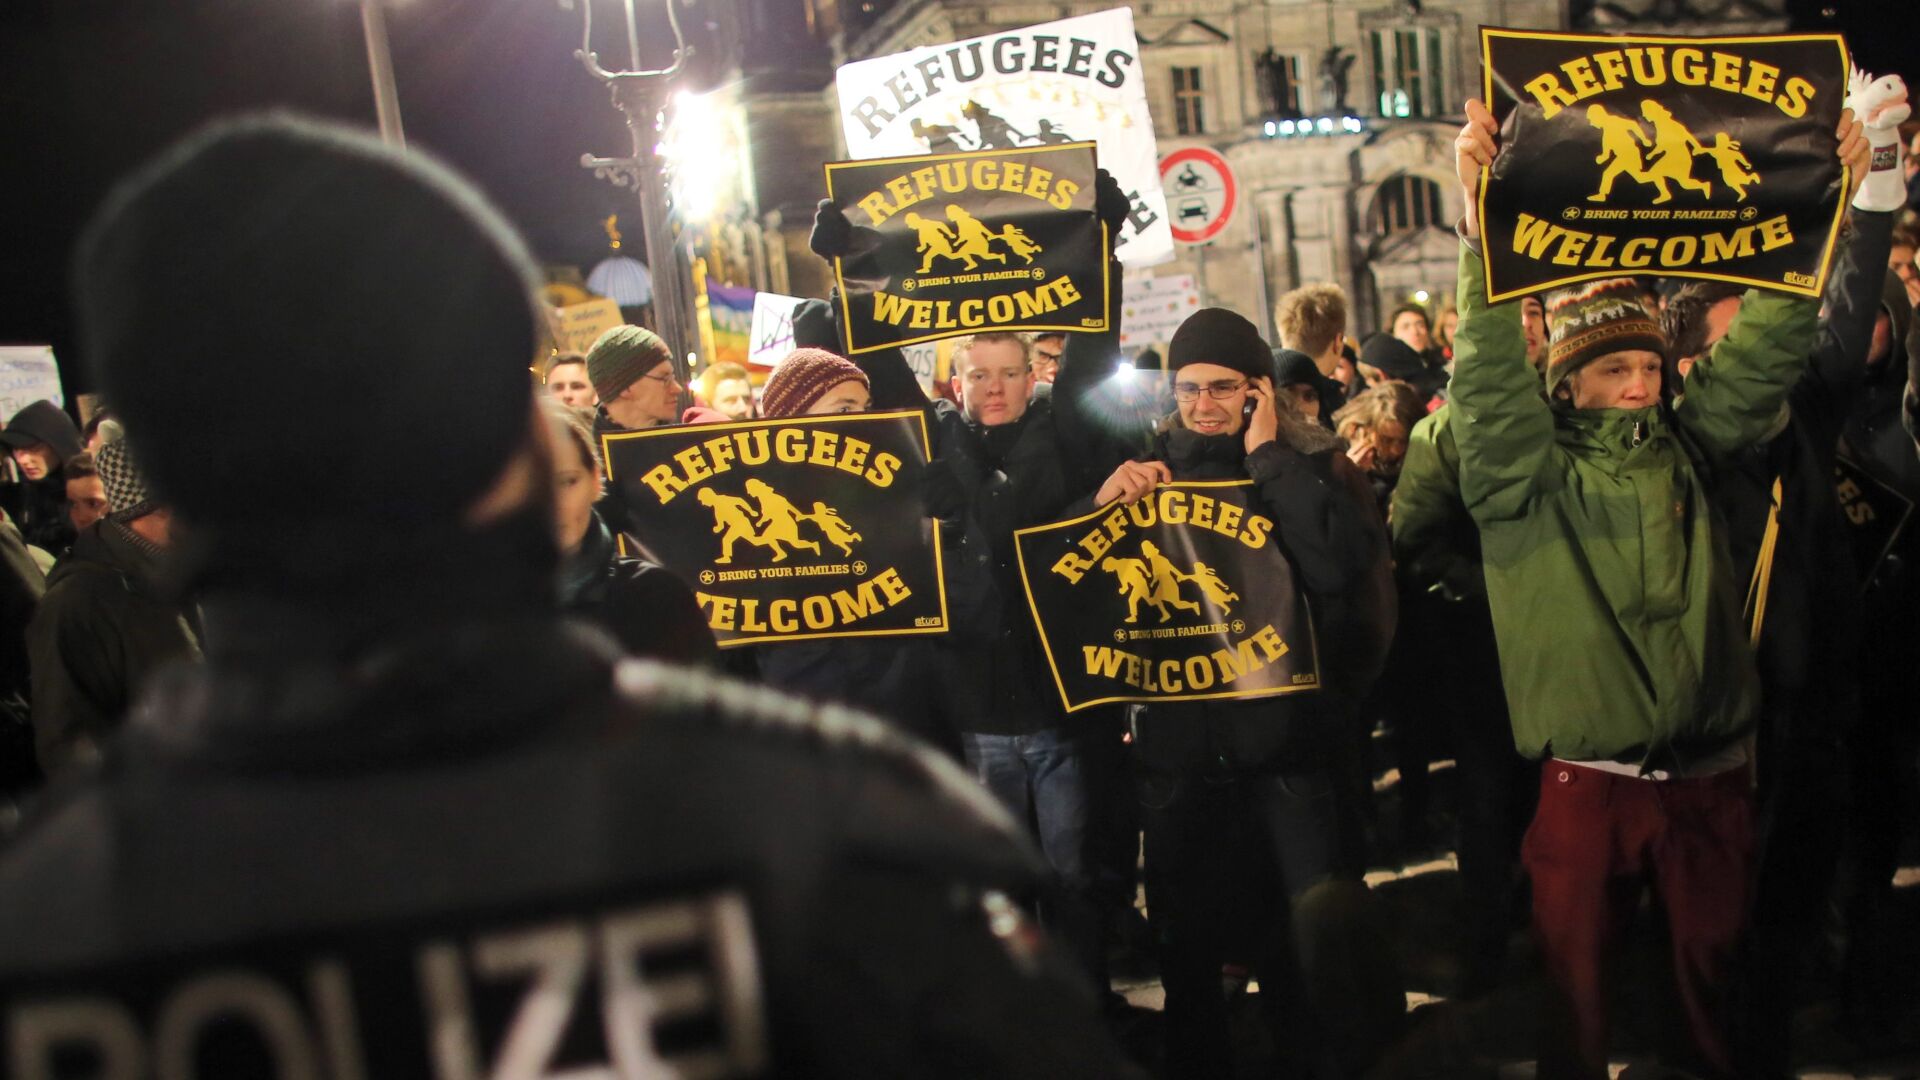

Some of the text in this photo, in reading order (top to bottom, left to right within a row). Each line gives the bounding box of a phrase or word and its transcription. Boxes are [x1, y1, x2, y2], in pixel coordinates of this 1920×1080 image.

[851, 35, 1133, 139] REFUGEES
[1524, 47, 1816, 120] REFUGEES
[857, 160, 1079, 227] REFUGEES
[1583, 209, 1737, 219] BRING YOUR FAMILIES
[1512, 213, 1794, 268] WELCOME
[873, 275, 1082, 328] WELCOME
[918, 269, 1030, 288] BRING YOUR FAMILIES
[641, 428, 902, 505] REFUGEES
[1051, 490, 1274, 585] REFUGEES
[718, 564, 849, 582] BRING YOUR FAMILIES
[1082, 624, 1289, 693] WELCOME
[1129, 623, 1230, 640] BRING YOUR FAMILIES
